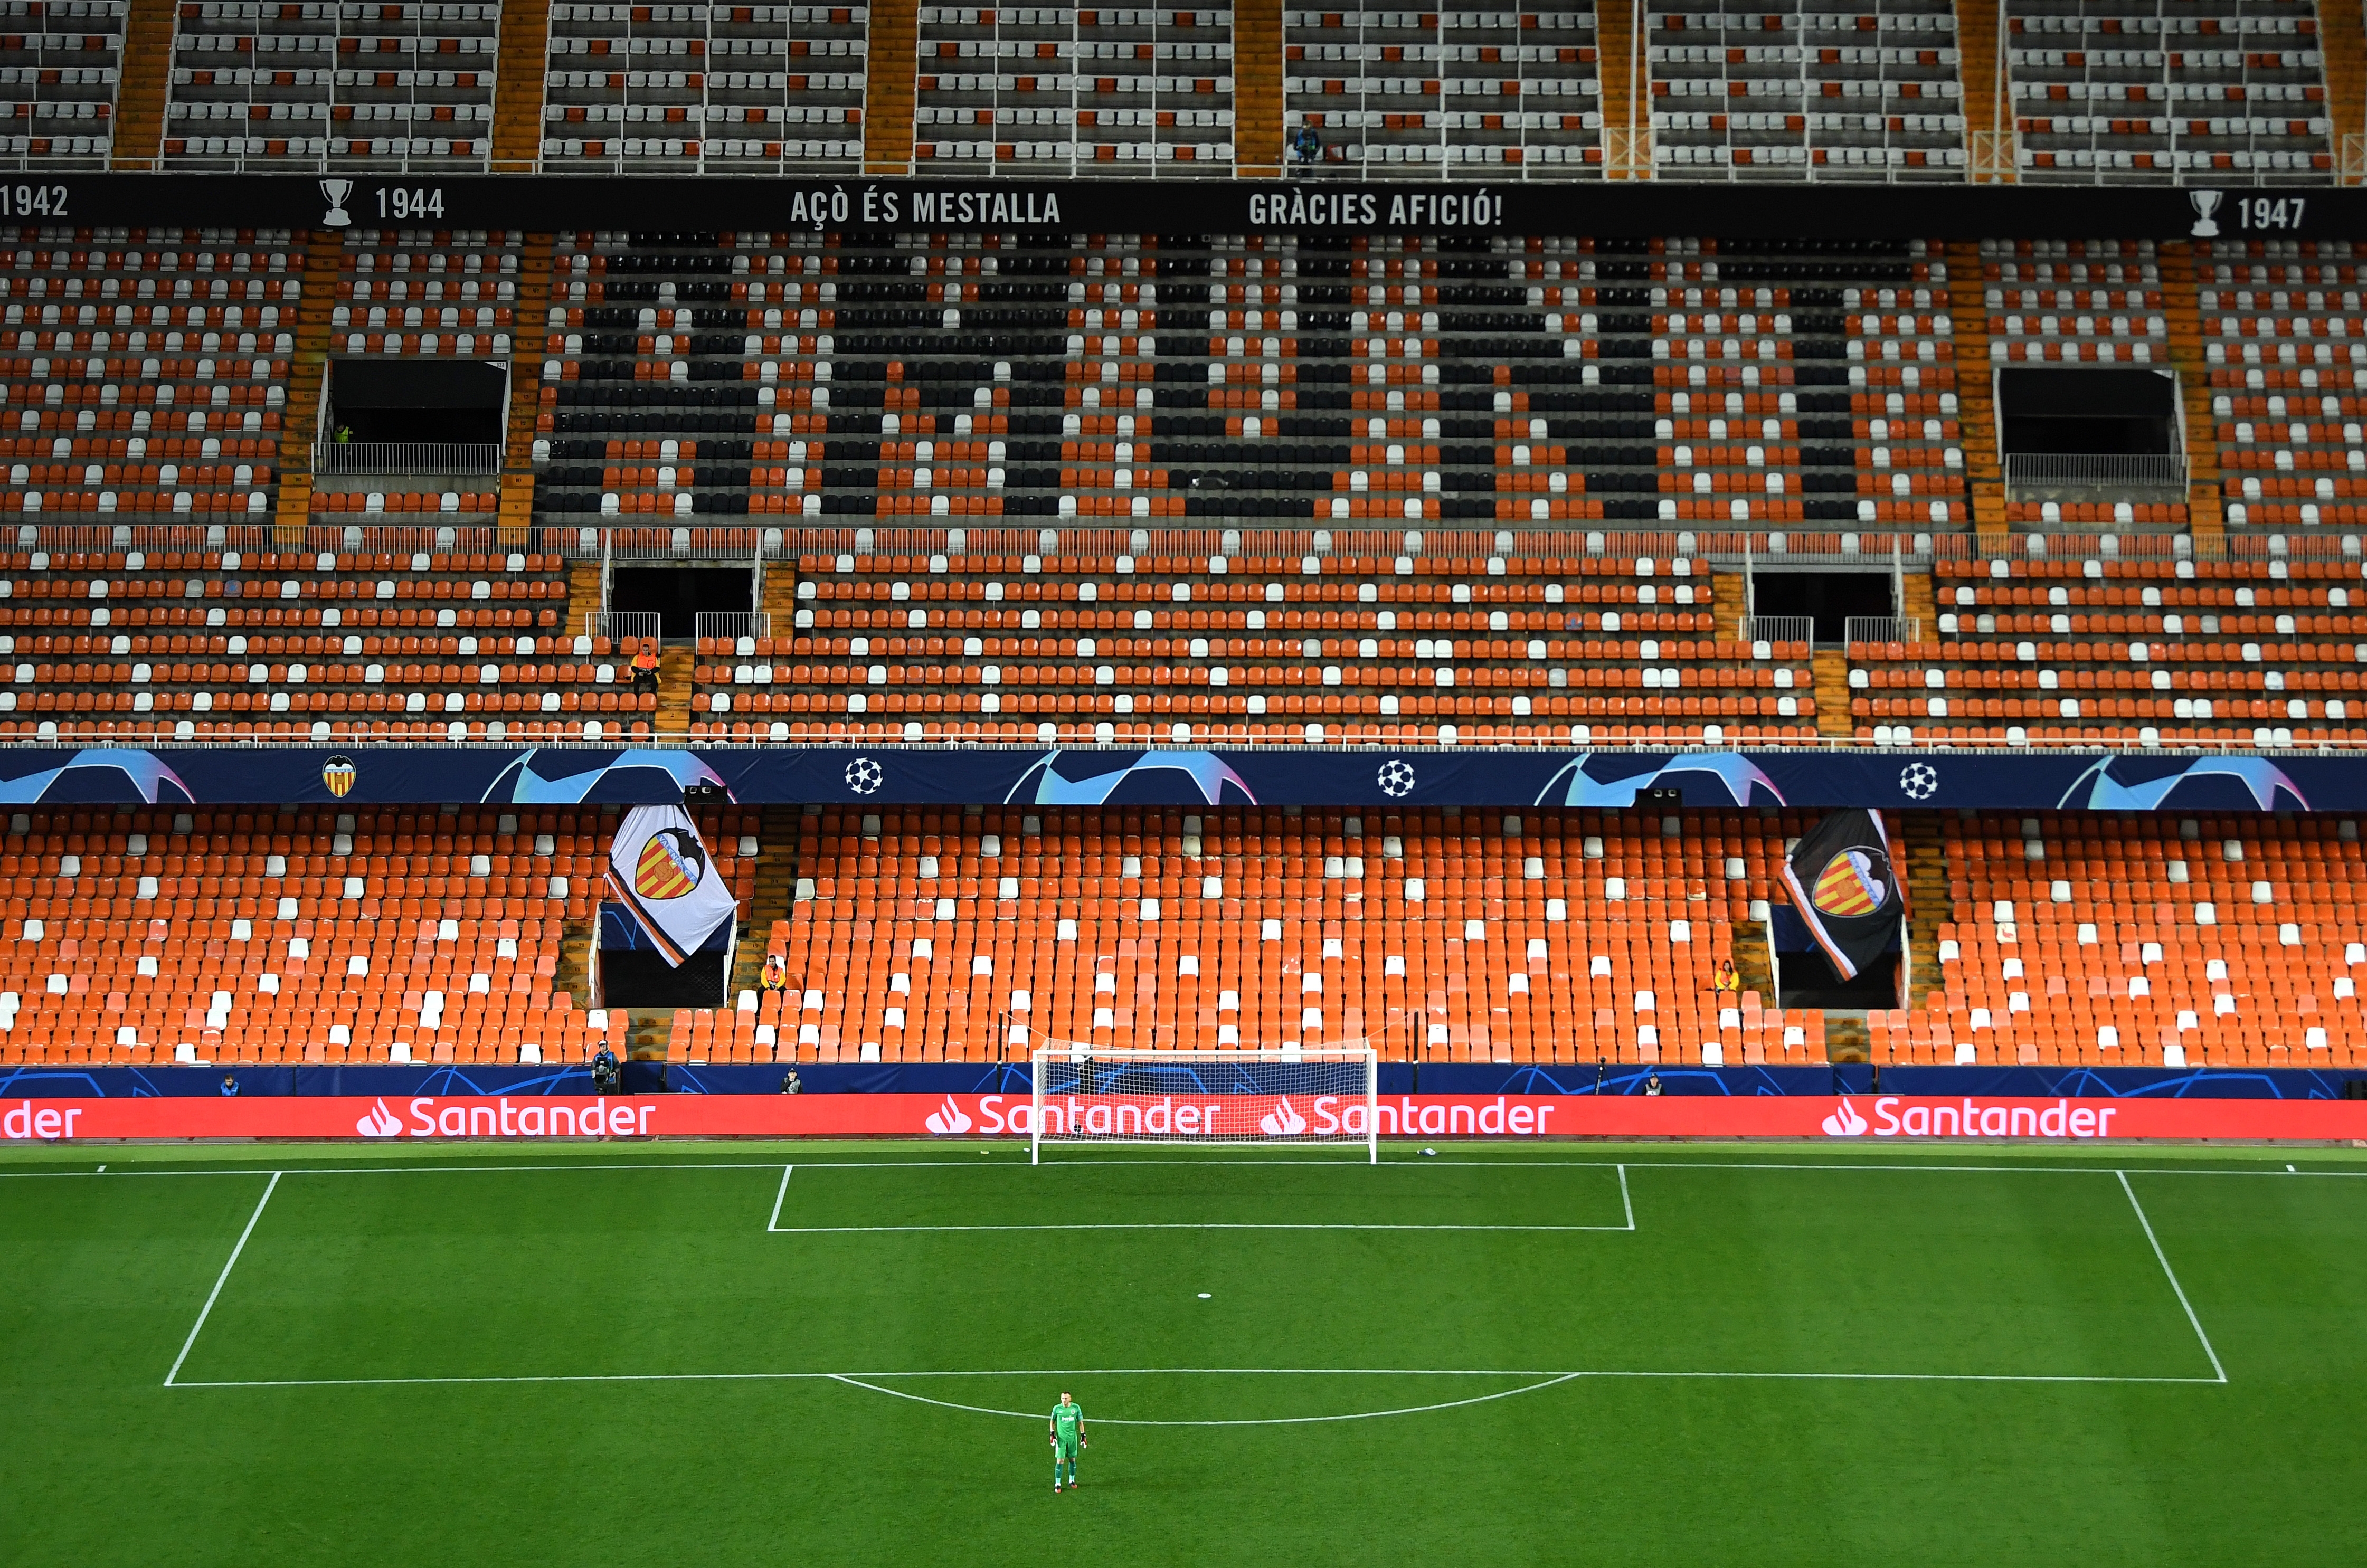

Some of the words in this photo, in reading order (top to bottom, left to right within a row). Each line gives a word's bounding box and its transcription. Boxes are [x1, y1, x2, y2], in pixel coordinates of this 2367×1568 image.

[0, 185, 68, 216] 1942
[376, 188, 444, 218] 1944
[790, 184, 849, 231] AÇÒ
[863, 185, 900, 222] ÉS
[913, 192, 1061, 223] MESTALLA
[1249, 187, 1377, 225] GRÀCIES
[1389, 188, 1502, 226] AFICIÓ!
[2238, 198, 2305, 229] 1947
[3, 1100, 82, 1138] der
[410, 1097, 656, 1136] Santander
[979, 1095, 1221, 1134] Santander
[1313, 1096, 1555, 1135] Santander
[1873, 1097, 2117, 1138] Santander
